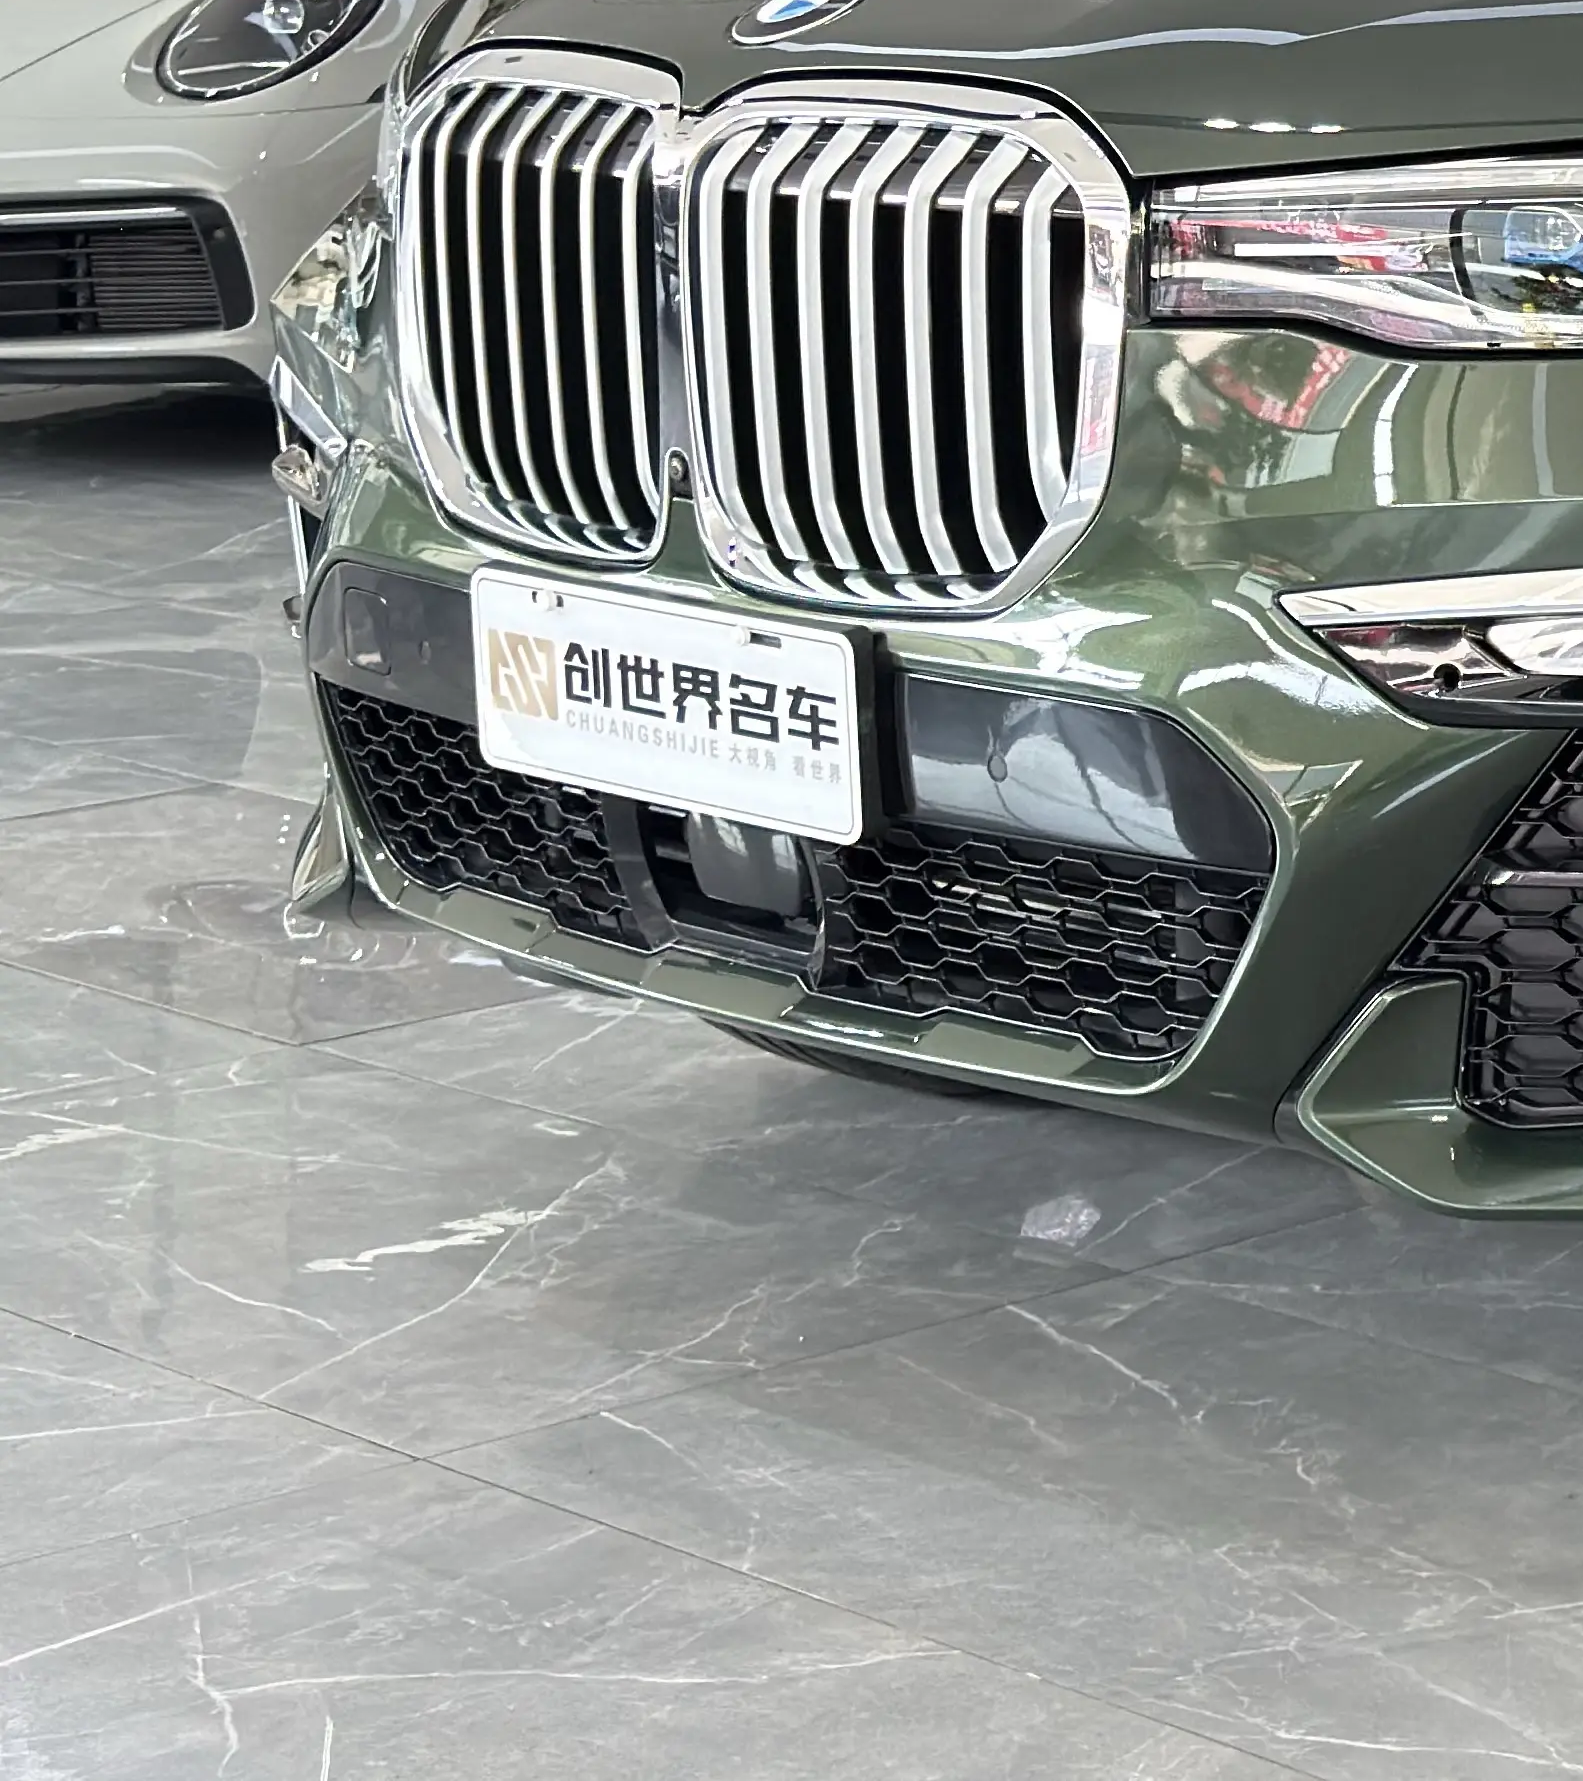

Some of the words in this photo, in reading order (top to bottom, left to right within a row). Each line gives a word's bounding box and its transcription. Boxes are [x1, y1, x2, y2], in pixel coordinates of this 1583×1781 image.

[563, 641, 840, 752] 创世界名车
[565, 709, 720, 760] CHUANGSHIJIE
[728, 742, 777, 772] 大视角
[792, 754, 843, 785] 看世界
